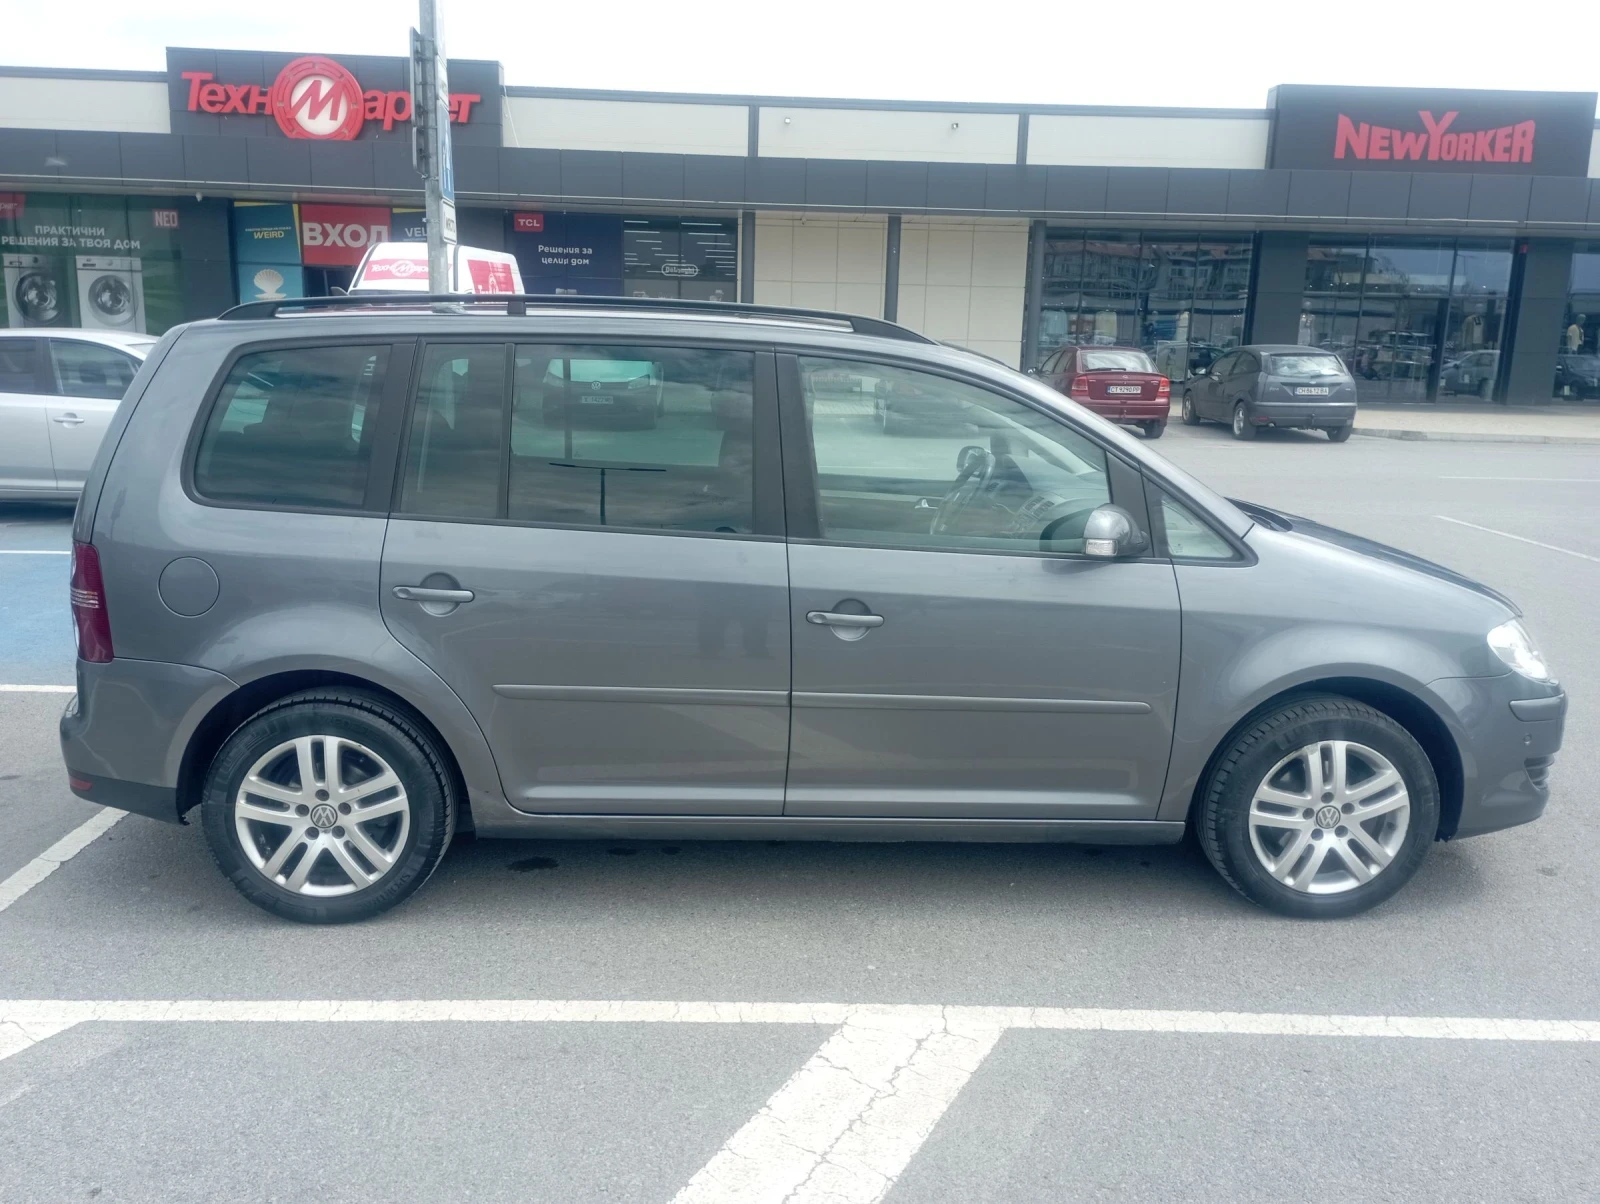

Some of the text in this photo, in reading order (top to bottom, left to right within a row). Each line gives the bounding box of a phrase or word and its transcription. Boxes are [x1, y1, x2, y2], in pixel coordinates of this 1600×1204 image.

[154, 211, 178, 227] NEO
[518, 218, 540, 227] TCL
[35, 225, 105, 237] ПРАКТИЧНИ
[253, 230, 285, 239] WEIRD
[302, 222, 389, 250] ВХОД
[404, 227, 428, 238] VEL
[1, 236, 141, 250] РЕШЕНИЯ ЗА ТВОЯ ДОМ
[538, 245, 593, 255] Решения за
